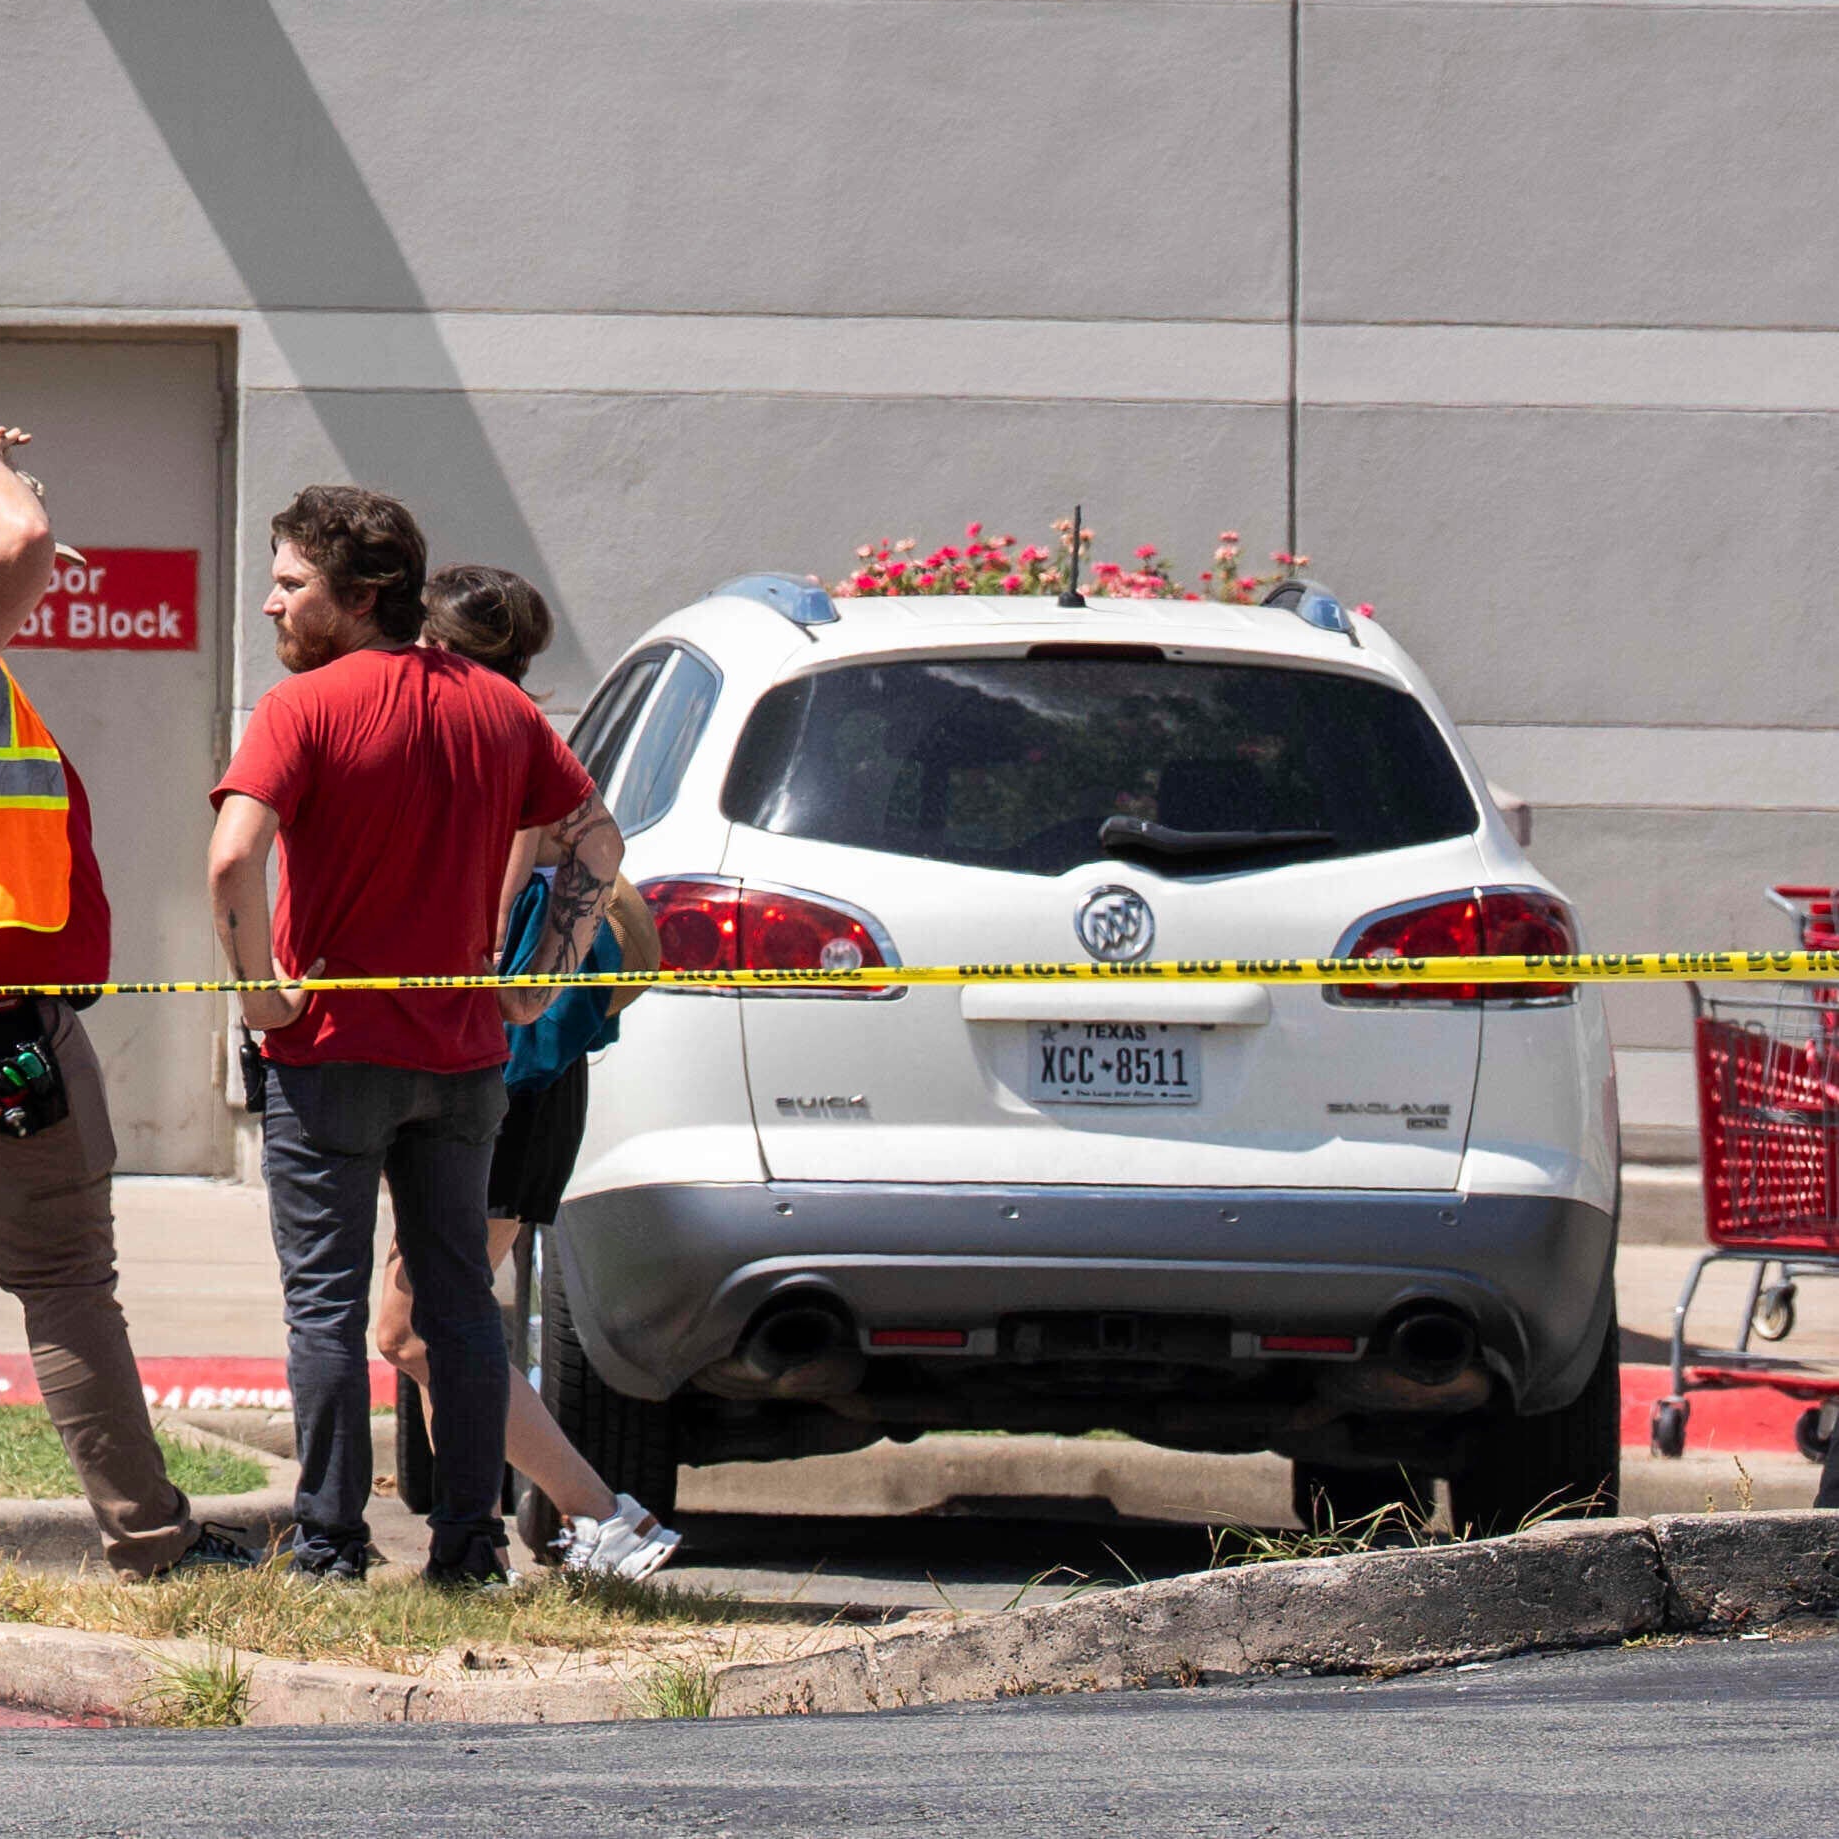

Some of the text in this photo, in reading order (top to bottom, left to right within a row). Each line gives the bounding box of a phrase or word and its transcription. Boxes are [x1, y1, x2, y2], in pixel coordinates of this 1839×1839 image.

[47, 567, 105, 594] oor
[19, 601, 182, 639] ot Block
[1084, 1024, 1147, 1041] TEXAS
